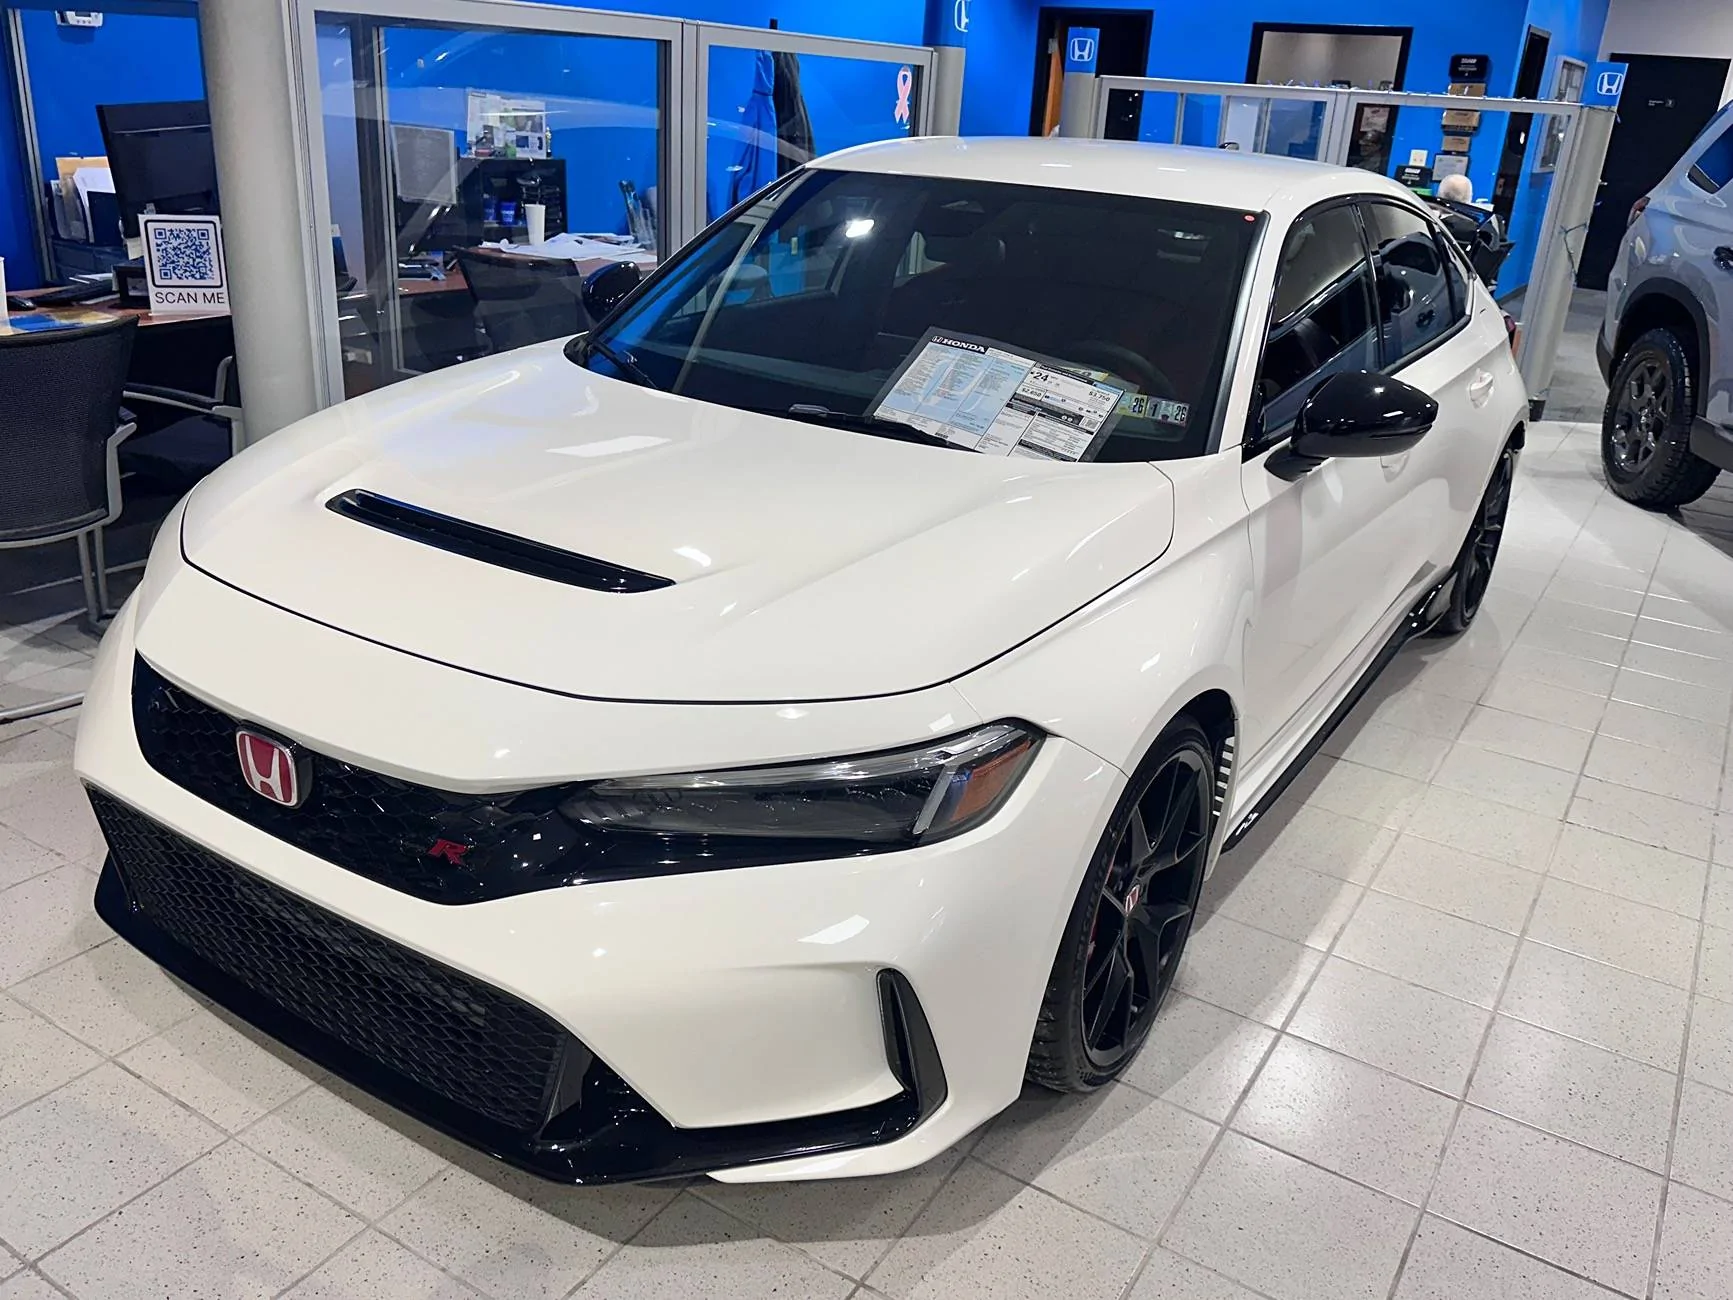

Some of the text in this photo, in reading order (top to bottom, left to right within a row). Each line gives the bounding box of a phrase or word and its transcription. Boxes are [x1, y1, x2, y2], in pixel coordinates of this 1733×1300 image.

[155, 292, 225, 304] SCAN ME
[942, 338, 986, 353] HONDA
[1033, 371, 1050, 382] 24
[1132, 397, 1145, 414] 26
[1174, 405, 1187, 422] 26
[426, 838, 469, 866] R
